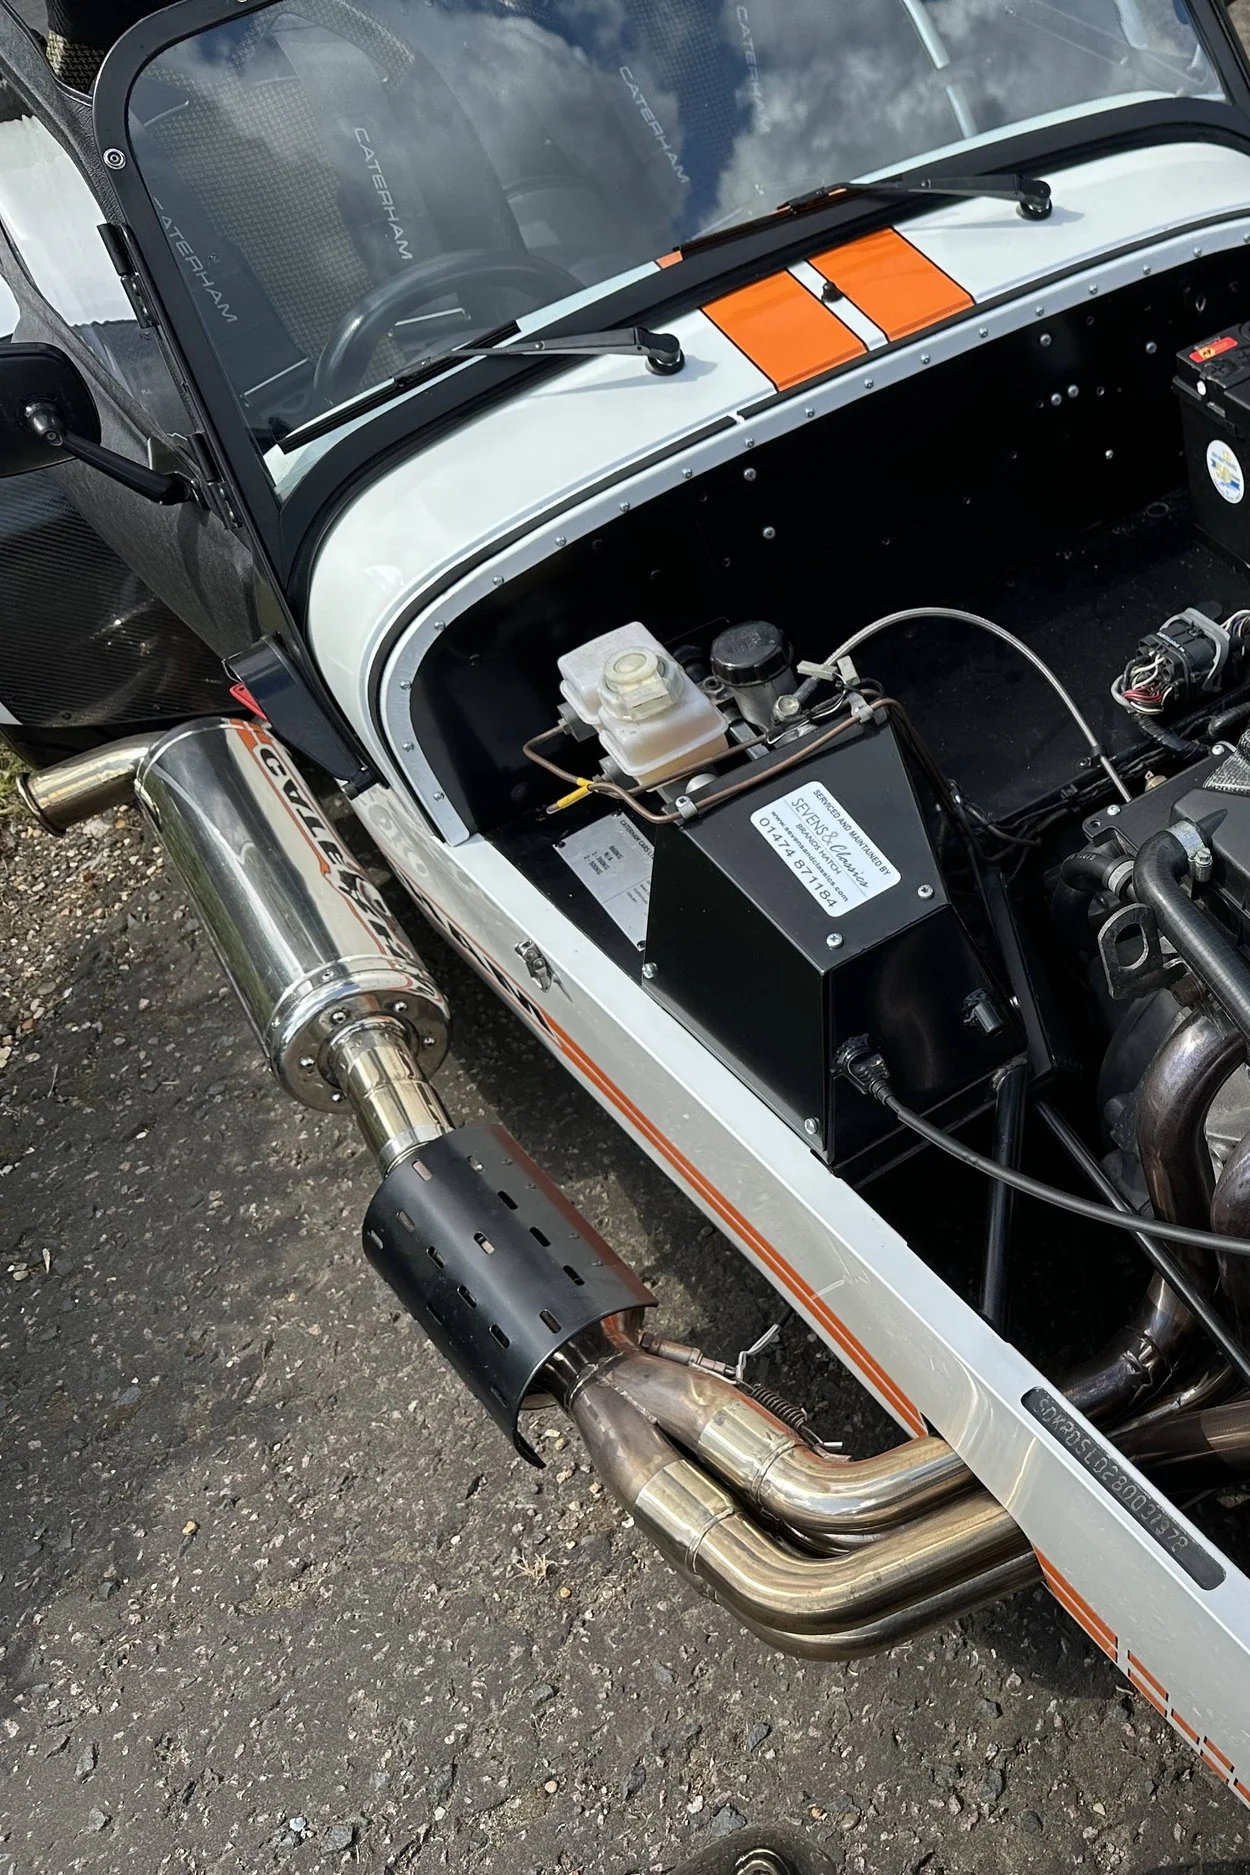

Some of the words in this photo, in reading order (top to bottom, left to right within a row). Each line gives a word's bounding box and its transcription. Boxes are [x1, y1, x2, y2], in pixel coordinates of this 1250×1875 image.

[736, 5, 771, 133] CATERHAM
[620, 65, 690, 184] CATERHAM
[354, 128, 412, 260] CATERHAM
[759, 817, 796, 857] 01474
[794, 859, 838, 908] 871184
[771, 810, 849, 902] www.sevensandclassics.com
[796, 823, 822, 851] BRANDS
[819, 849, 842, 875] HATCH
[813, 789, 840, 819] SERVICED
[838, 818, 851, 832] AND
[850, 831, 882, 867] MAINTAINED
[879, 865, 892, 876] BY
